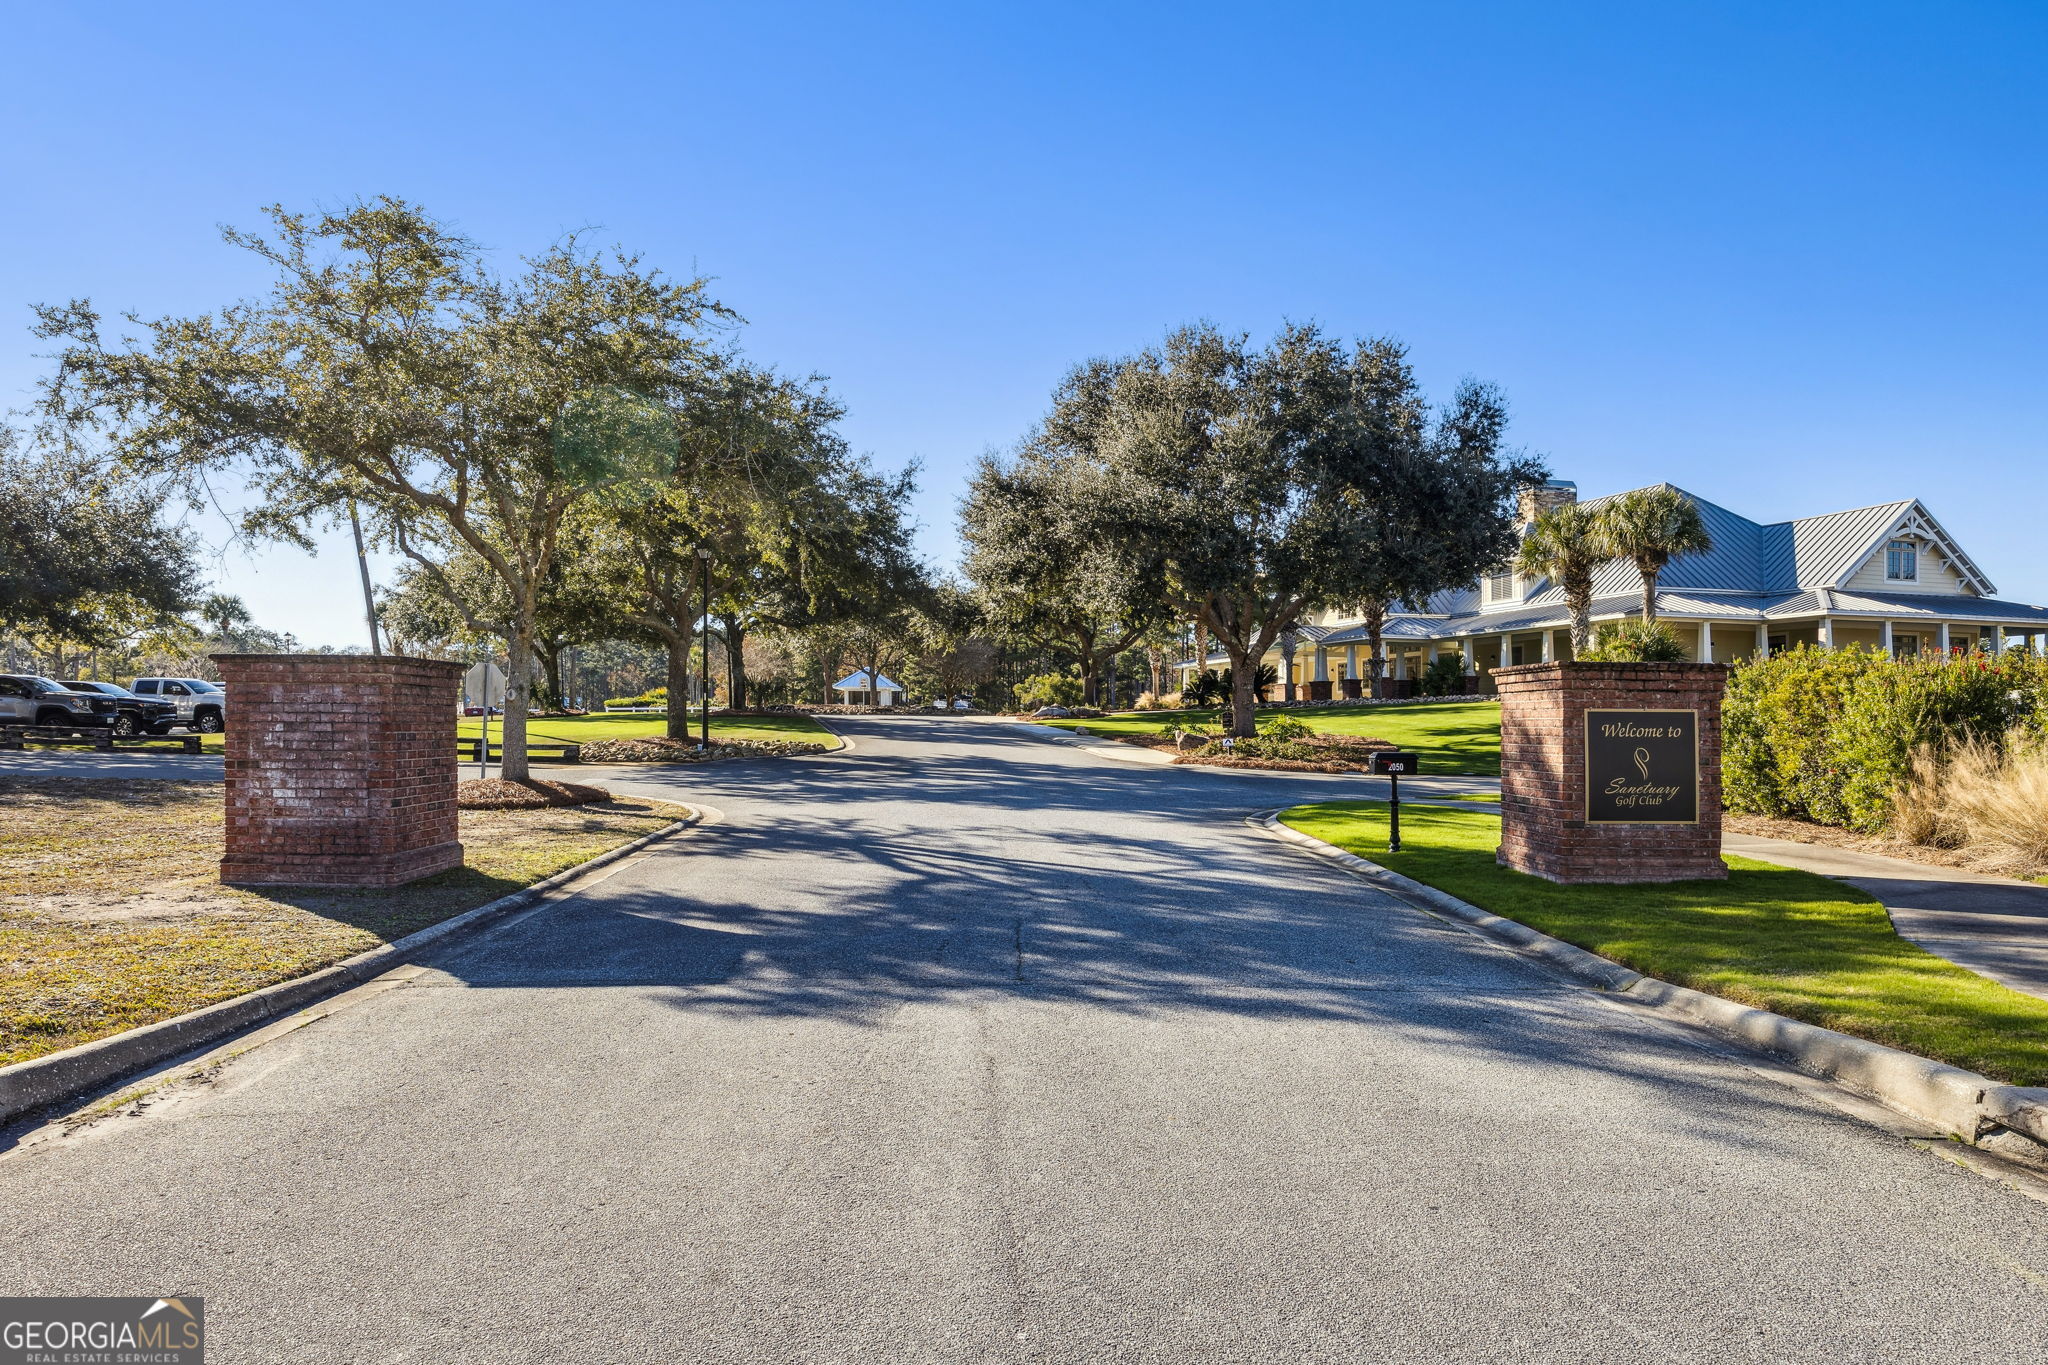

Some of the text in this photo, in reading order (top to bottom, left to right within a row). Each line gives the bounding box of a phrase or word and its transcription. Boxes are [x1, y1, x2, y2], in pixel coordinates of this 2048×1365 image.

[1601, 722, 1682, 738] Welcome to
[1388, 762, 1404, 771] 2050
[1604, 777, 1680, 801] Sanctuary
[1615, 795, 1662, 808] Golf Club
